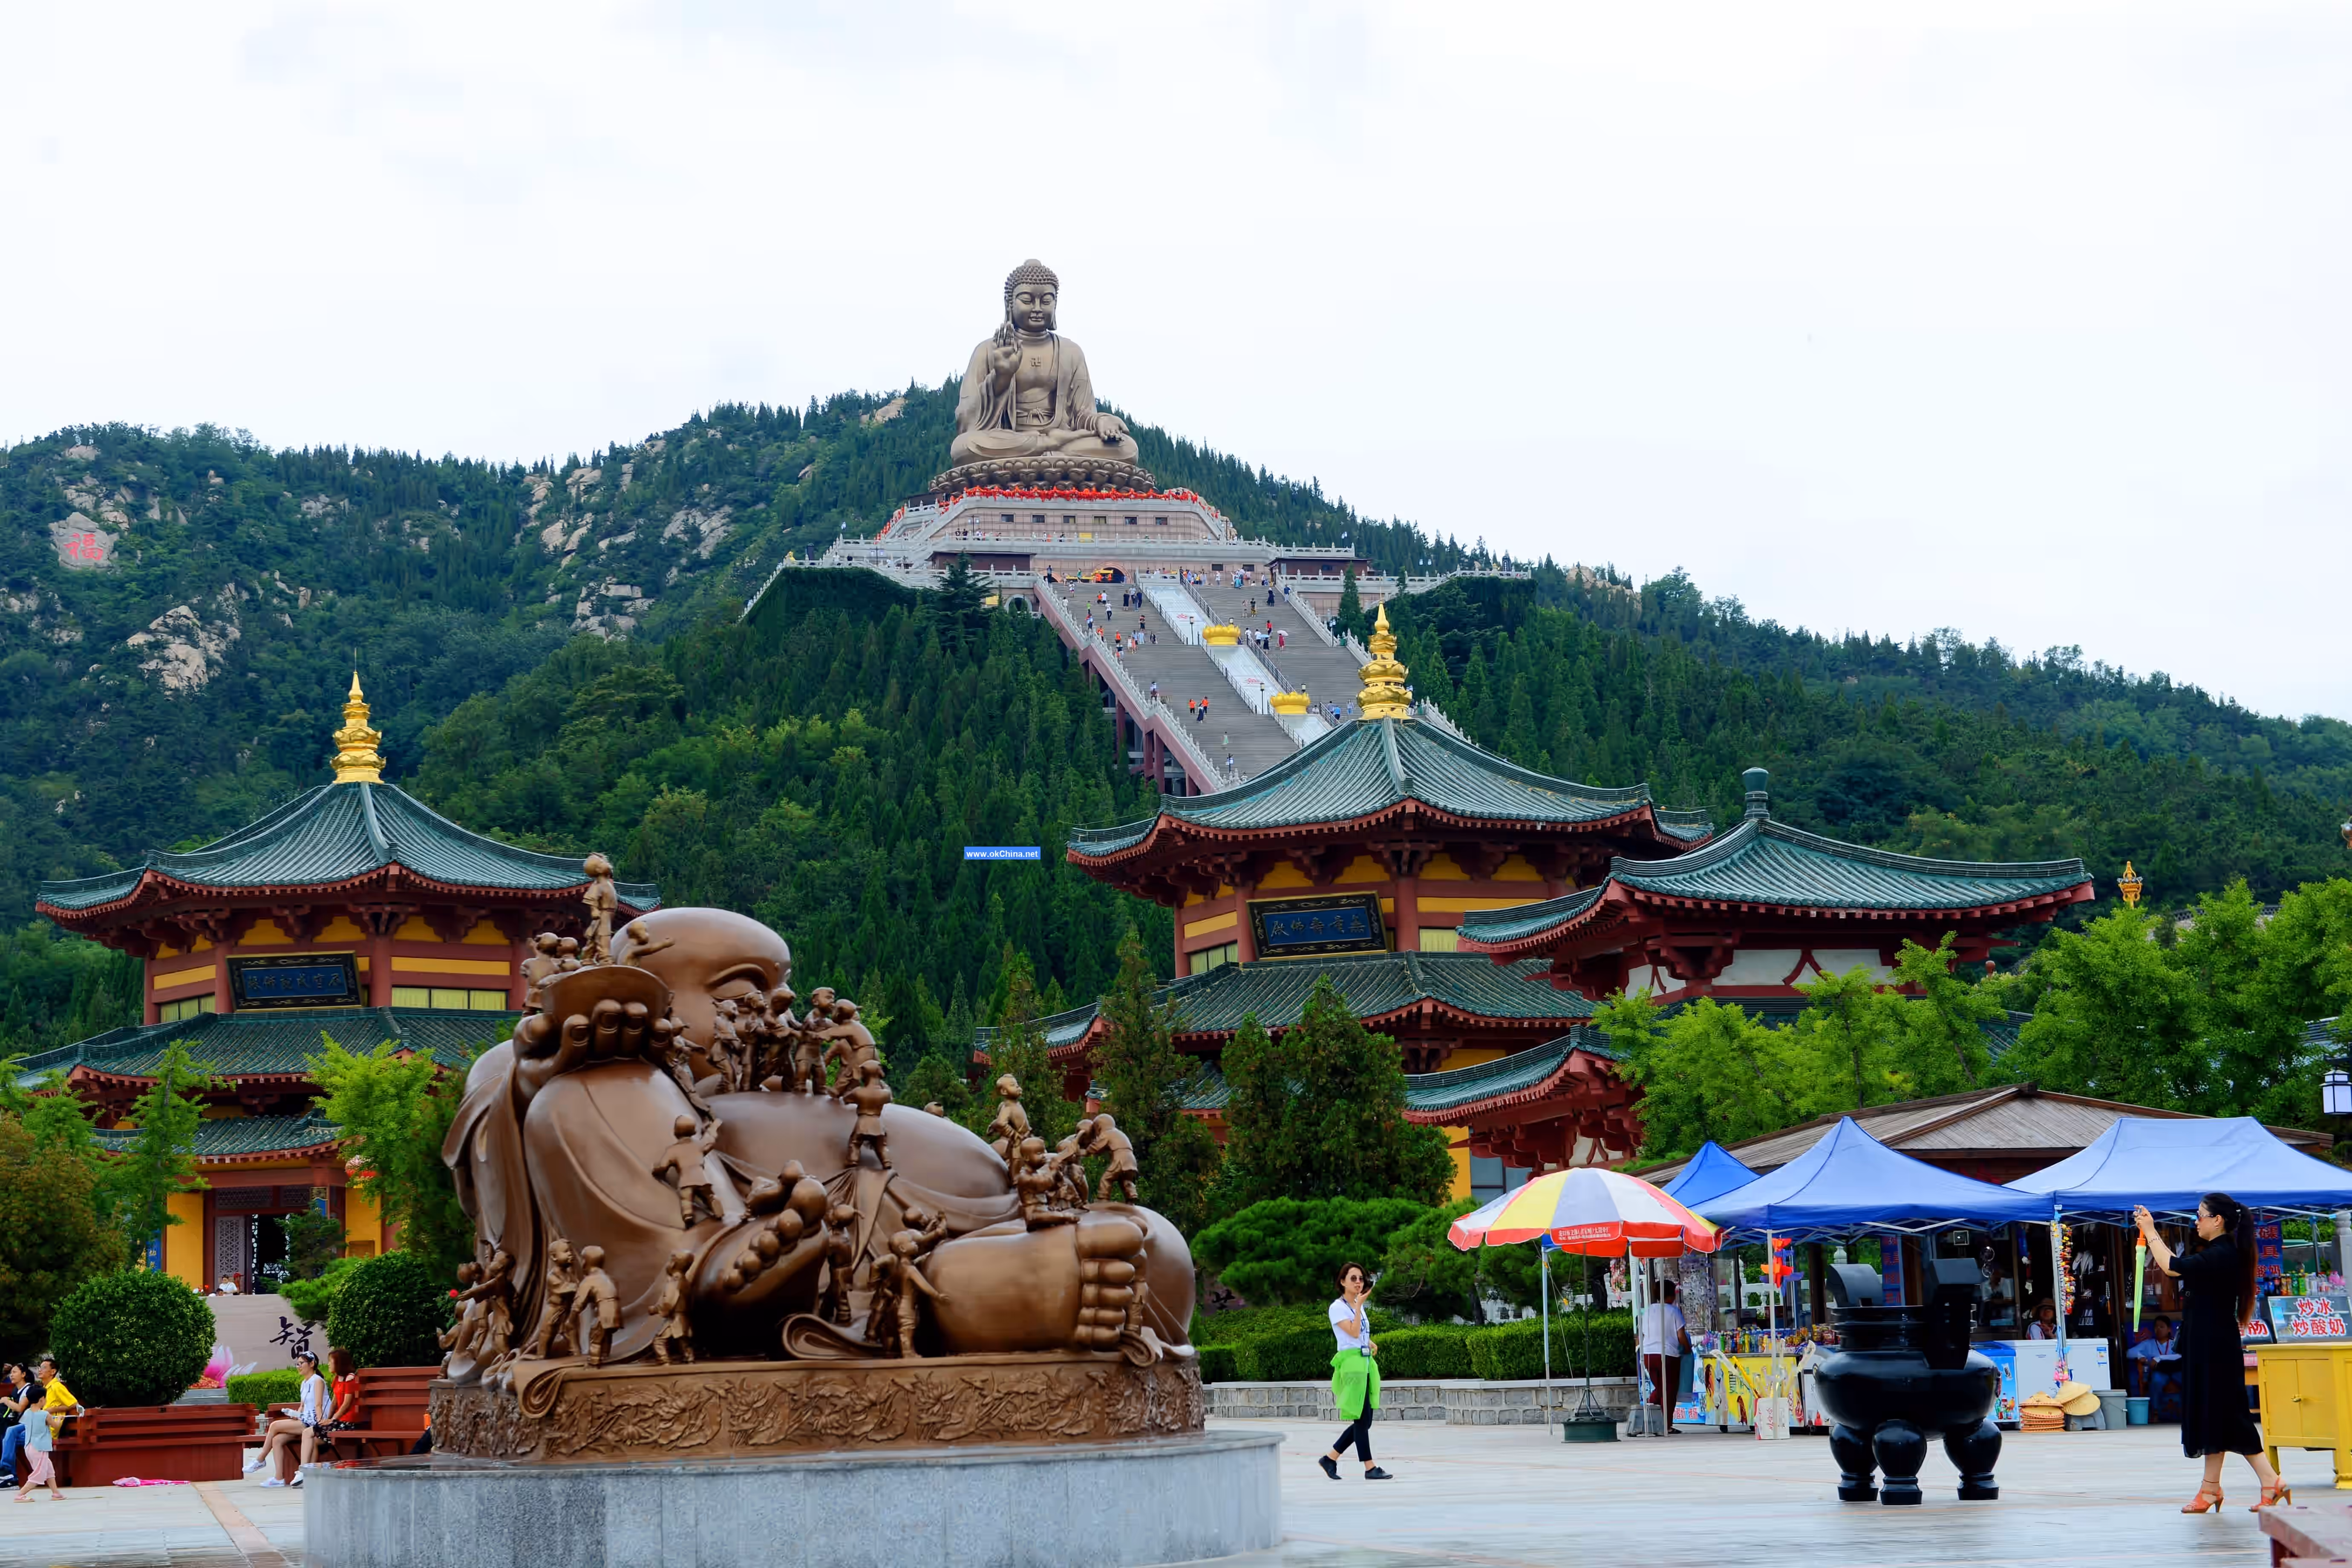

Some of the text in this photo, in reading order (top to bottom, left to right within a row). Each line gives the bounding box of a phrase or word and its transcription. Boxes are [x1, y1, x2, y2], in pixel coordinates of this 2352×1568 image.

[63, 533, 104, 560] 福
[2297, 1297, 2333, 1316] 炒冰
[269, 1316, 317, 1359] 智
[2292, 1318, 2346, 1336] 炒酸奶
